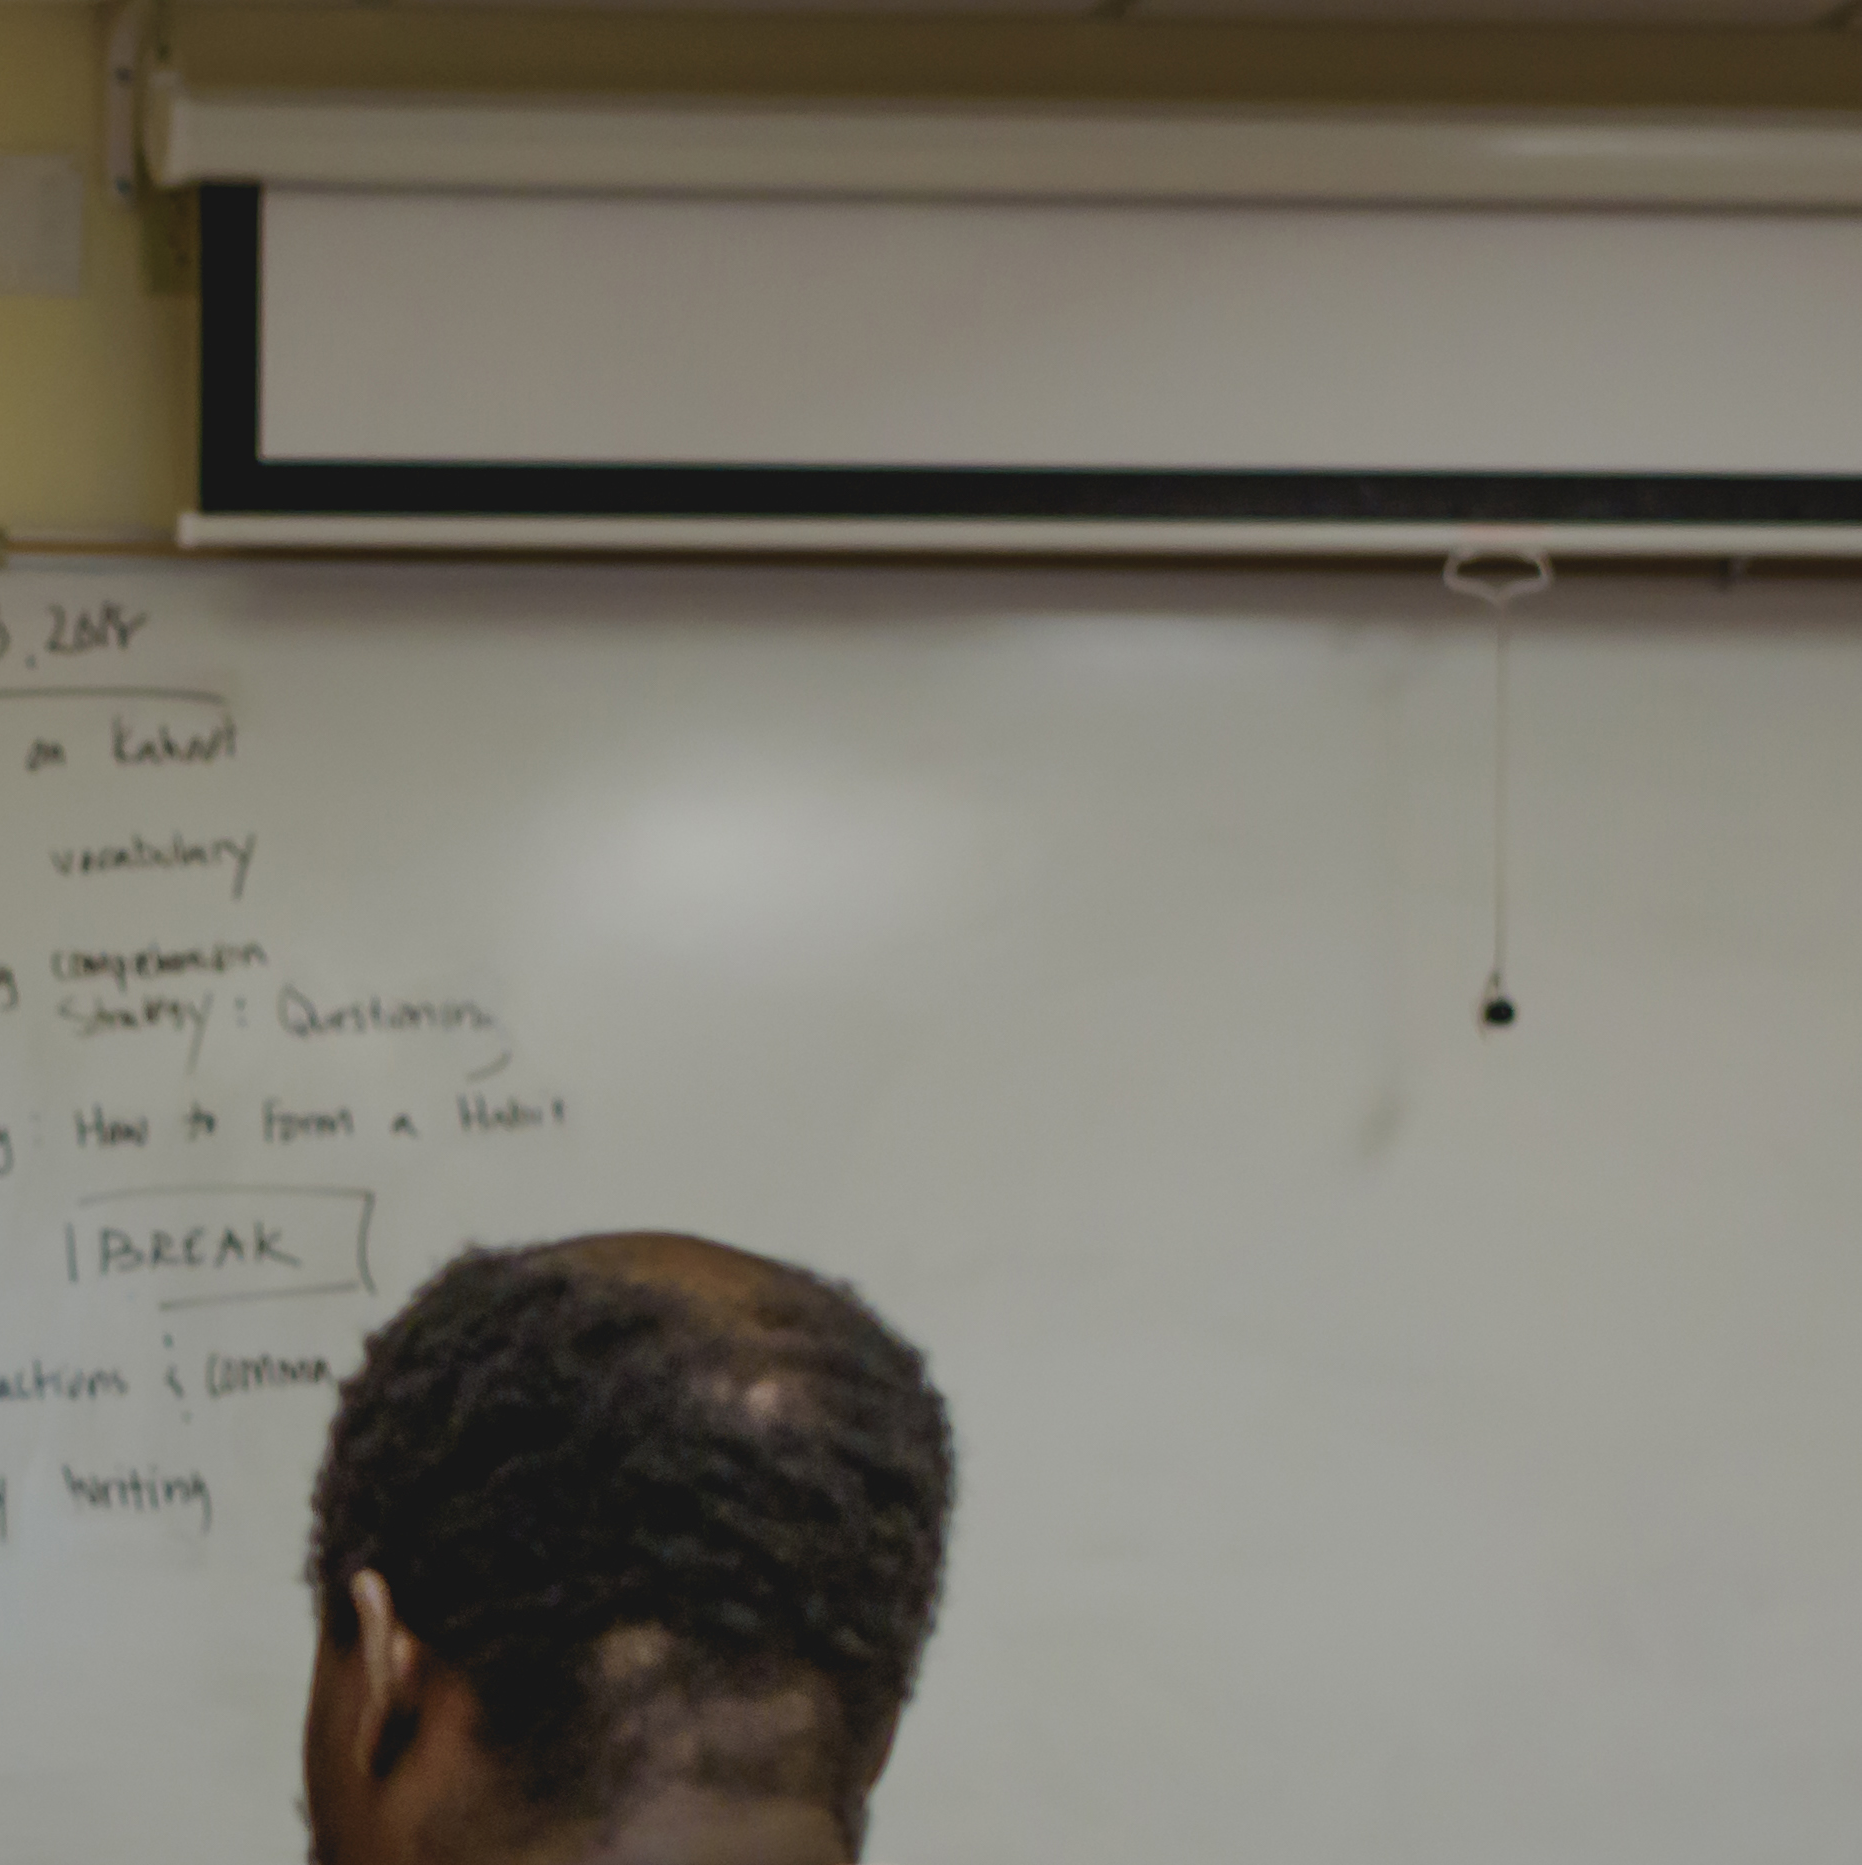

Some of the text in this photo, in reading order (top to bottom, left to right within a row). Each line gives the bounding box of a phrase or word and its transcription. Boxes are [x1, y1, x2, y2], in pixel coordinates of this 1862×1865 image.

[25, 736, 66, 771] on
[48, 829, 258, 901] vocabulary
[72, 1104, 149, 1149] How
[185, 1101, 218, 1143] to
[97, 1227, 301, 1276] BREAK
